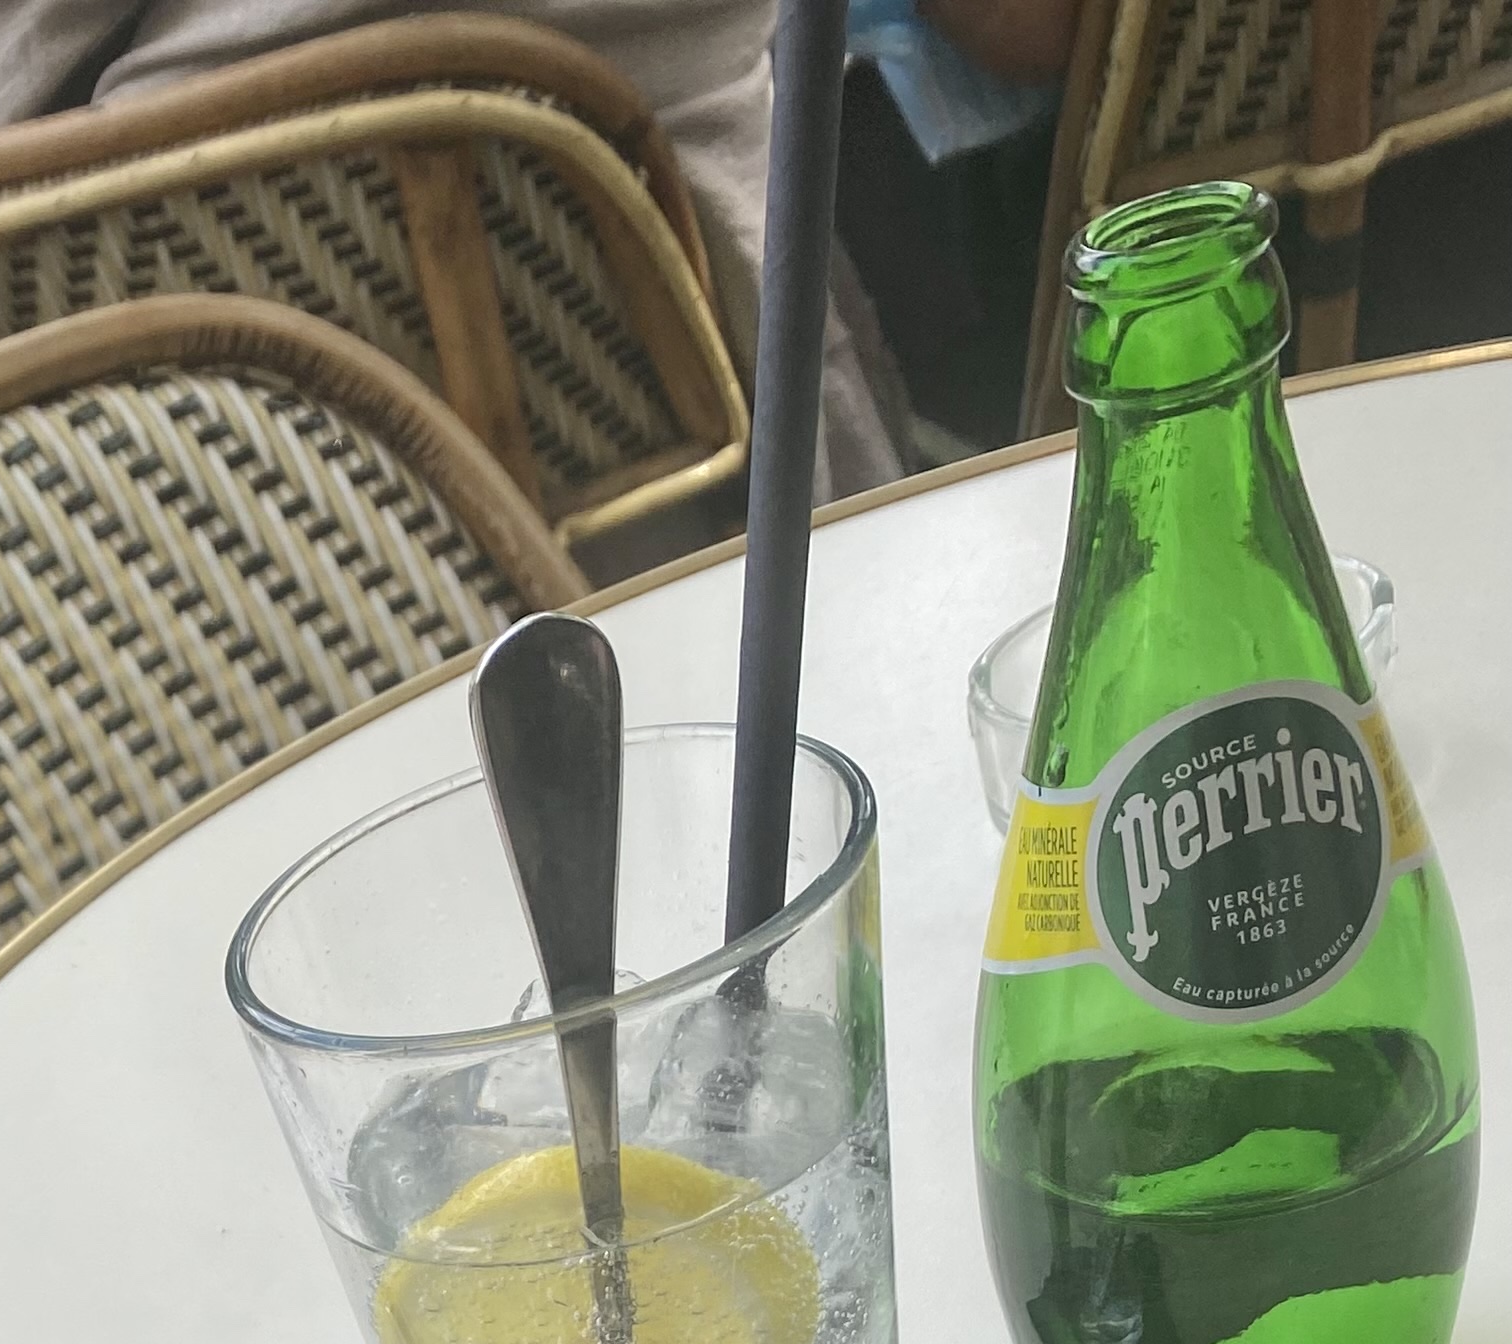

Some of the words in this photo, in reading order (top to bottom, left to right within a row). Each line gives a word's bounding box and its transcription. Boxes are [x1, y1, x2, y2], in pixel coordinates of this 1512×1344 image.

[1162, 734, 1257, 789] SOURCE
[1032, 821, 1077, 855] MINÉRALE
[1026, 859, 1079, 888] NATURELLE
[1207, 873, 1304, 913] VERGÈZE
[1210, 892, 1305, 931] FRANCE
[1236, 919, 1287, 945] 1863
[1172, 976, 1202, 998] Eau
[1296, 968, 1313, 982] la
